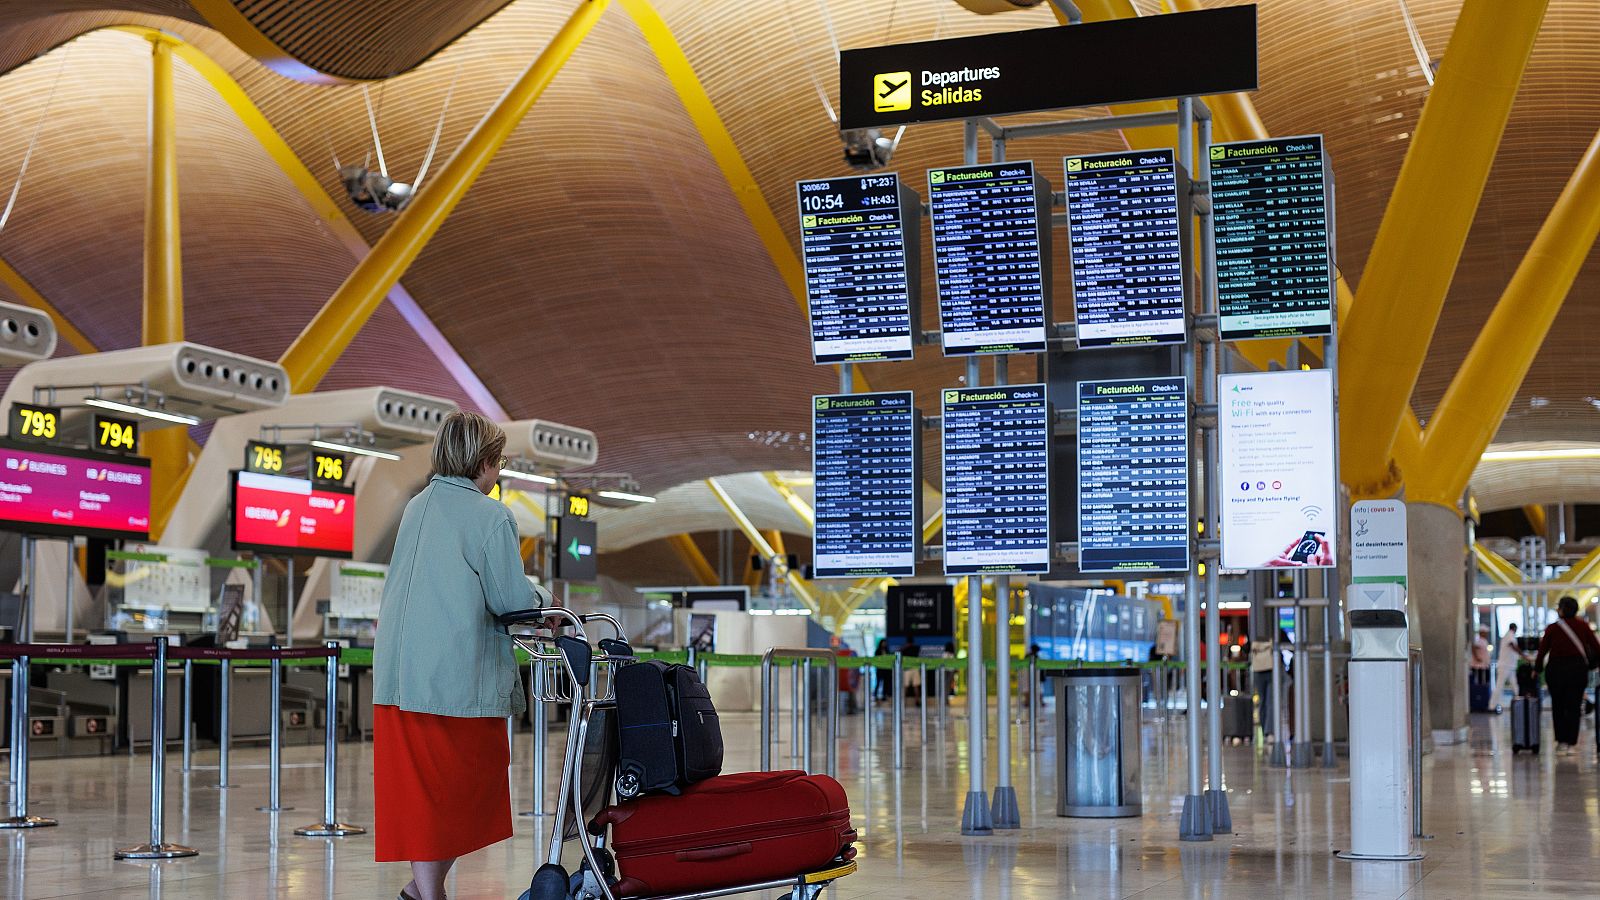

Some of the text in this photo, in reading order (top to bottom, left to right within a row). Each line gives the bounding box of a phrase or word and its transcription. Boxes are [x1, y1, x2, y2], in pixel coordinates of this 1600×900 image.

[922, 66, 1000, 87] Departures
[921, 86, 982, 106] Salidas
[1228, 144, 1314, 157] Facturación Check-in
[1084, 156, 1166, 169] Facturación Check-in
[946, 169, 1026, 181] Facturación Check-in
[803, 194, 844, 210] 10:54
[818, 214, 894, 225] Facturación Check-in
[960, 392, 1006, 401] Facturación
[1097, 386, 1144, 394] Facturación
[831, 400, 874, 408] Facturación
[20, 409, 56, 438] 793
[100, 421, 134, 449] 794
[255, 446, 282, 471] 795
[29, 461, 67, 476] BUSINESS
[316, 456, 342, 480] 796
[107, 470, 142, 485] BUSINESS
[309, 496, 335, 509] IBERIA
[245, 506, 278, 521] IBERIA
